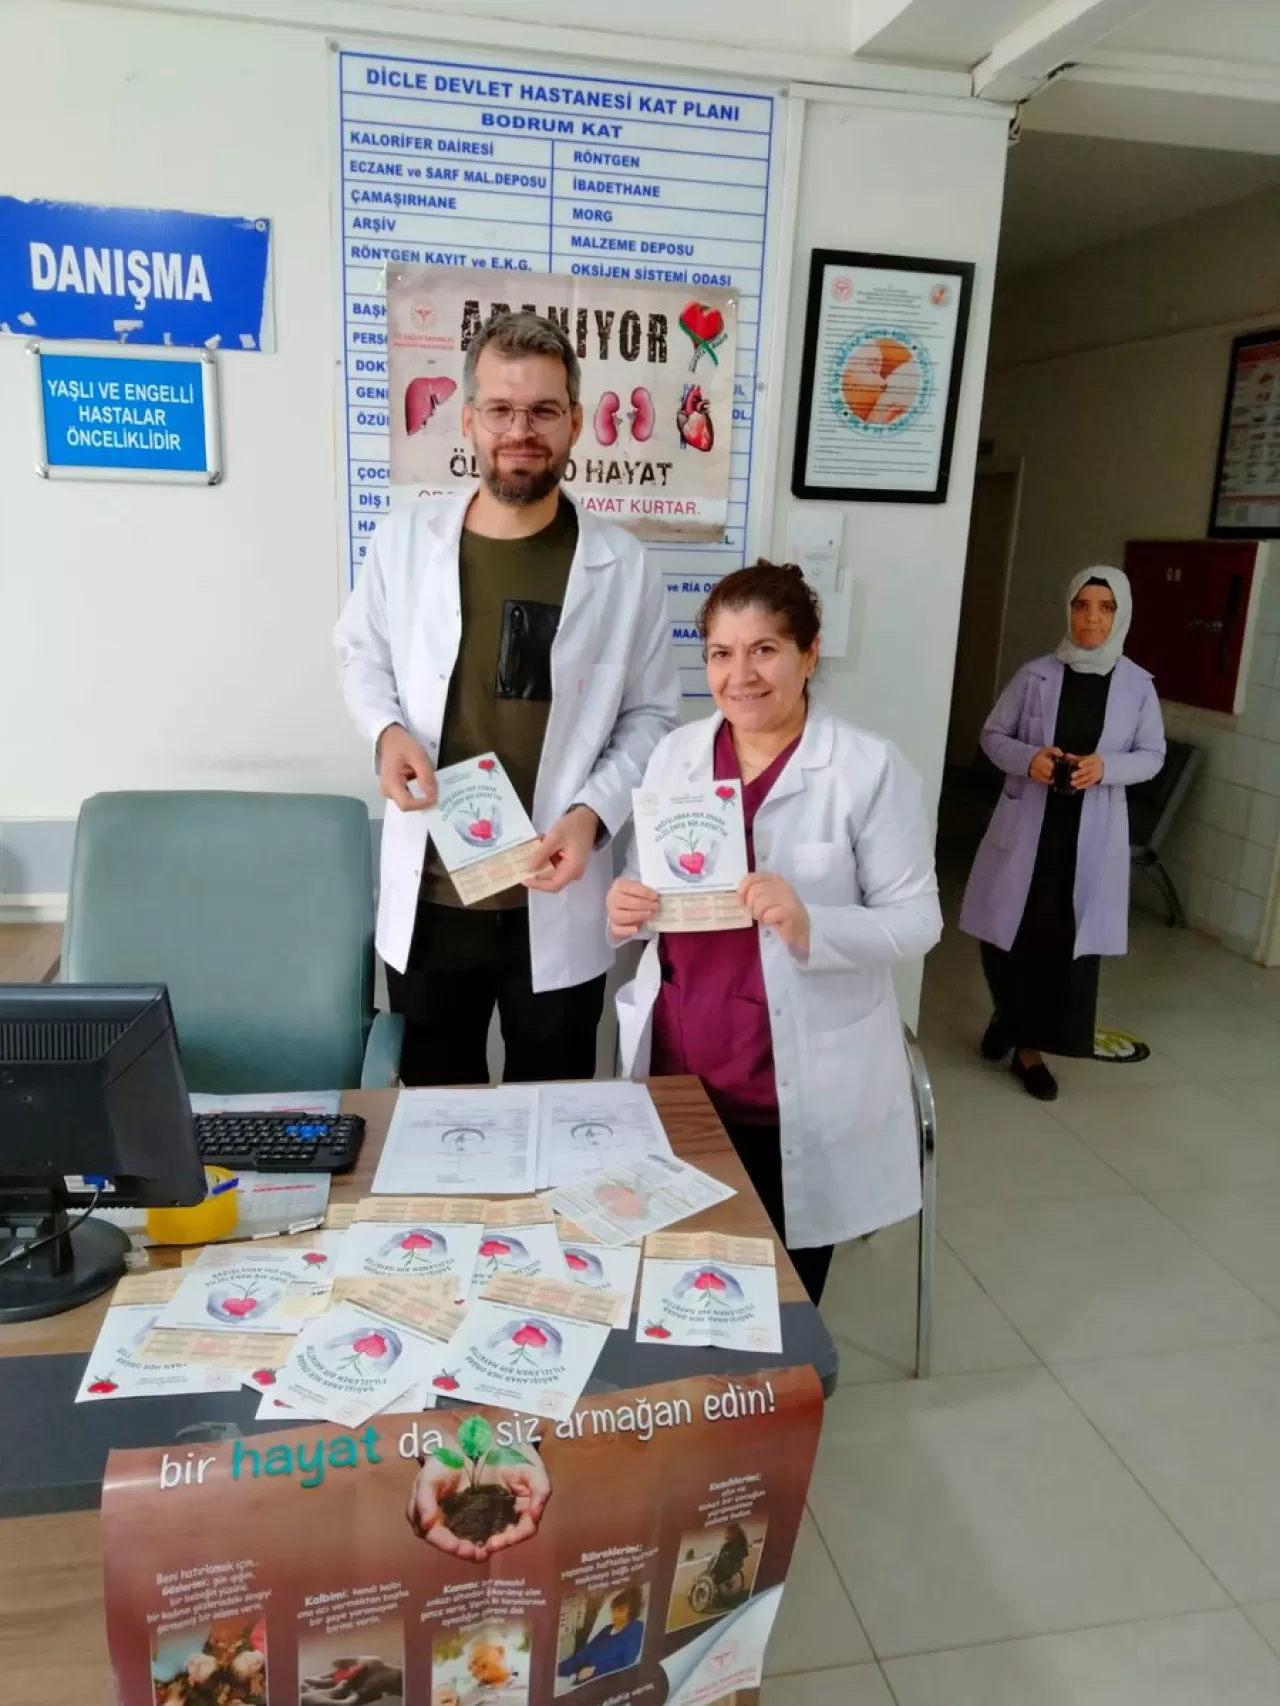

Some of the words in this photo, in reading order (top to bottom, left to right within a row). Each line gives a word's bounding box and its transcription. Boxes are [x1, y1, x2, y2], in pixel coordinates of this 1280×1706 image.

[366, 66, 428, 90] DİCLE
[434, 75, 513, 99] DEVLET
[520, 84, 632, 111] HASTANESİ
[640, 96, 677, 117] KAT
[684, 101, 740, 122] PLANI
[481, 112, 574, 134] BODRUM
[582, 122, 623, 139] KAT
[350, 131, 433, 151] KALORİFER
[438, 136, 494, 156] DAİRESİ
[574, 149, 640, 168] RÖNTGEN
[350, 160, 403, 177] ECZANE
[407, 168, 421, 178] ve
[426, 167, 459, 182] SARF
[464, 170, 547, 189] MAL.DEPOSU
[573, 176, 660, 198] İBADETHANE
[351, 189, 457, 210] ÇAMAŞIRHANE
[352, 216, 396, 233] ARŞİV
[572, 207, 613, 223] MORG
[351, 244, 421, 263] RÖNTGEN
[425, 252, 467, 267] KAYIT
[472, 258, 487, 268] ve
[491, 257, 532, 272] E.K.G.
[571, 235, 637, 252] MALZEME
[640, 241, 694, 257] DEPOSU
[29, 242, 212, 311] DANIŞMA
[571, 262, 630, 279] OKSİJEN
[635, 266, 688, 284] SİSTEMİ
[692, 273, 732, 287] ODASI
[47, 379, 95, 402] YAŞLI
[98, 382, 120, 400] VE
[124, 382, 194, 404] ENGELLİ
[79, 405, 166, 426] HASTALAR
[66, 426, 181, 451] ÖNCELİKLİDİR
[586, 458, 673, 486] HAYAT
[359, 492, 382, 509] DİŞ
[630, 499, 701, 516] KURTAR.
[160, 1451, 217, 1490] bir
[231, 1424, 384, 1489] hayat
[398, 1421, 444, 1459] da
[495, 1412, 543, 1446] siz
[554, 1396, 692, 1441] armağan
[703, 1381, 776, 1421] edin!
